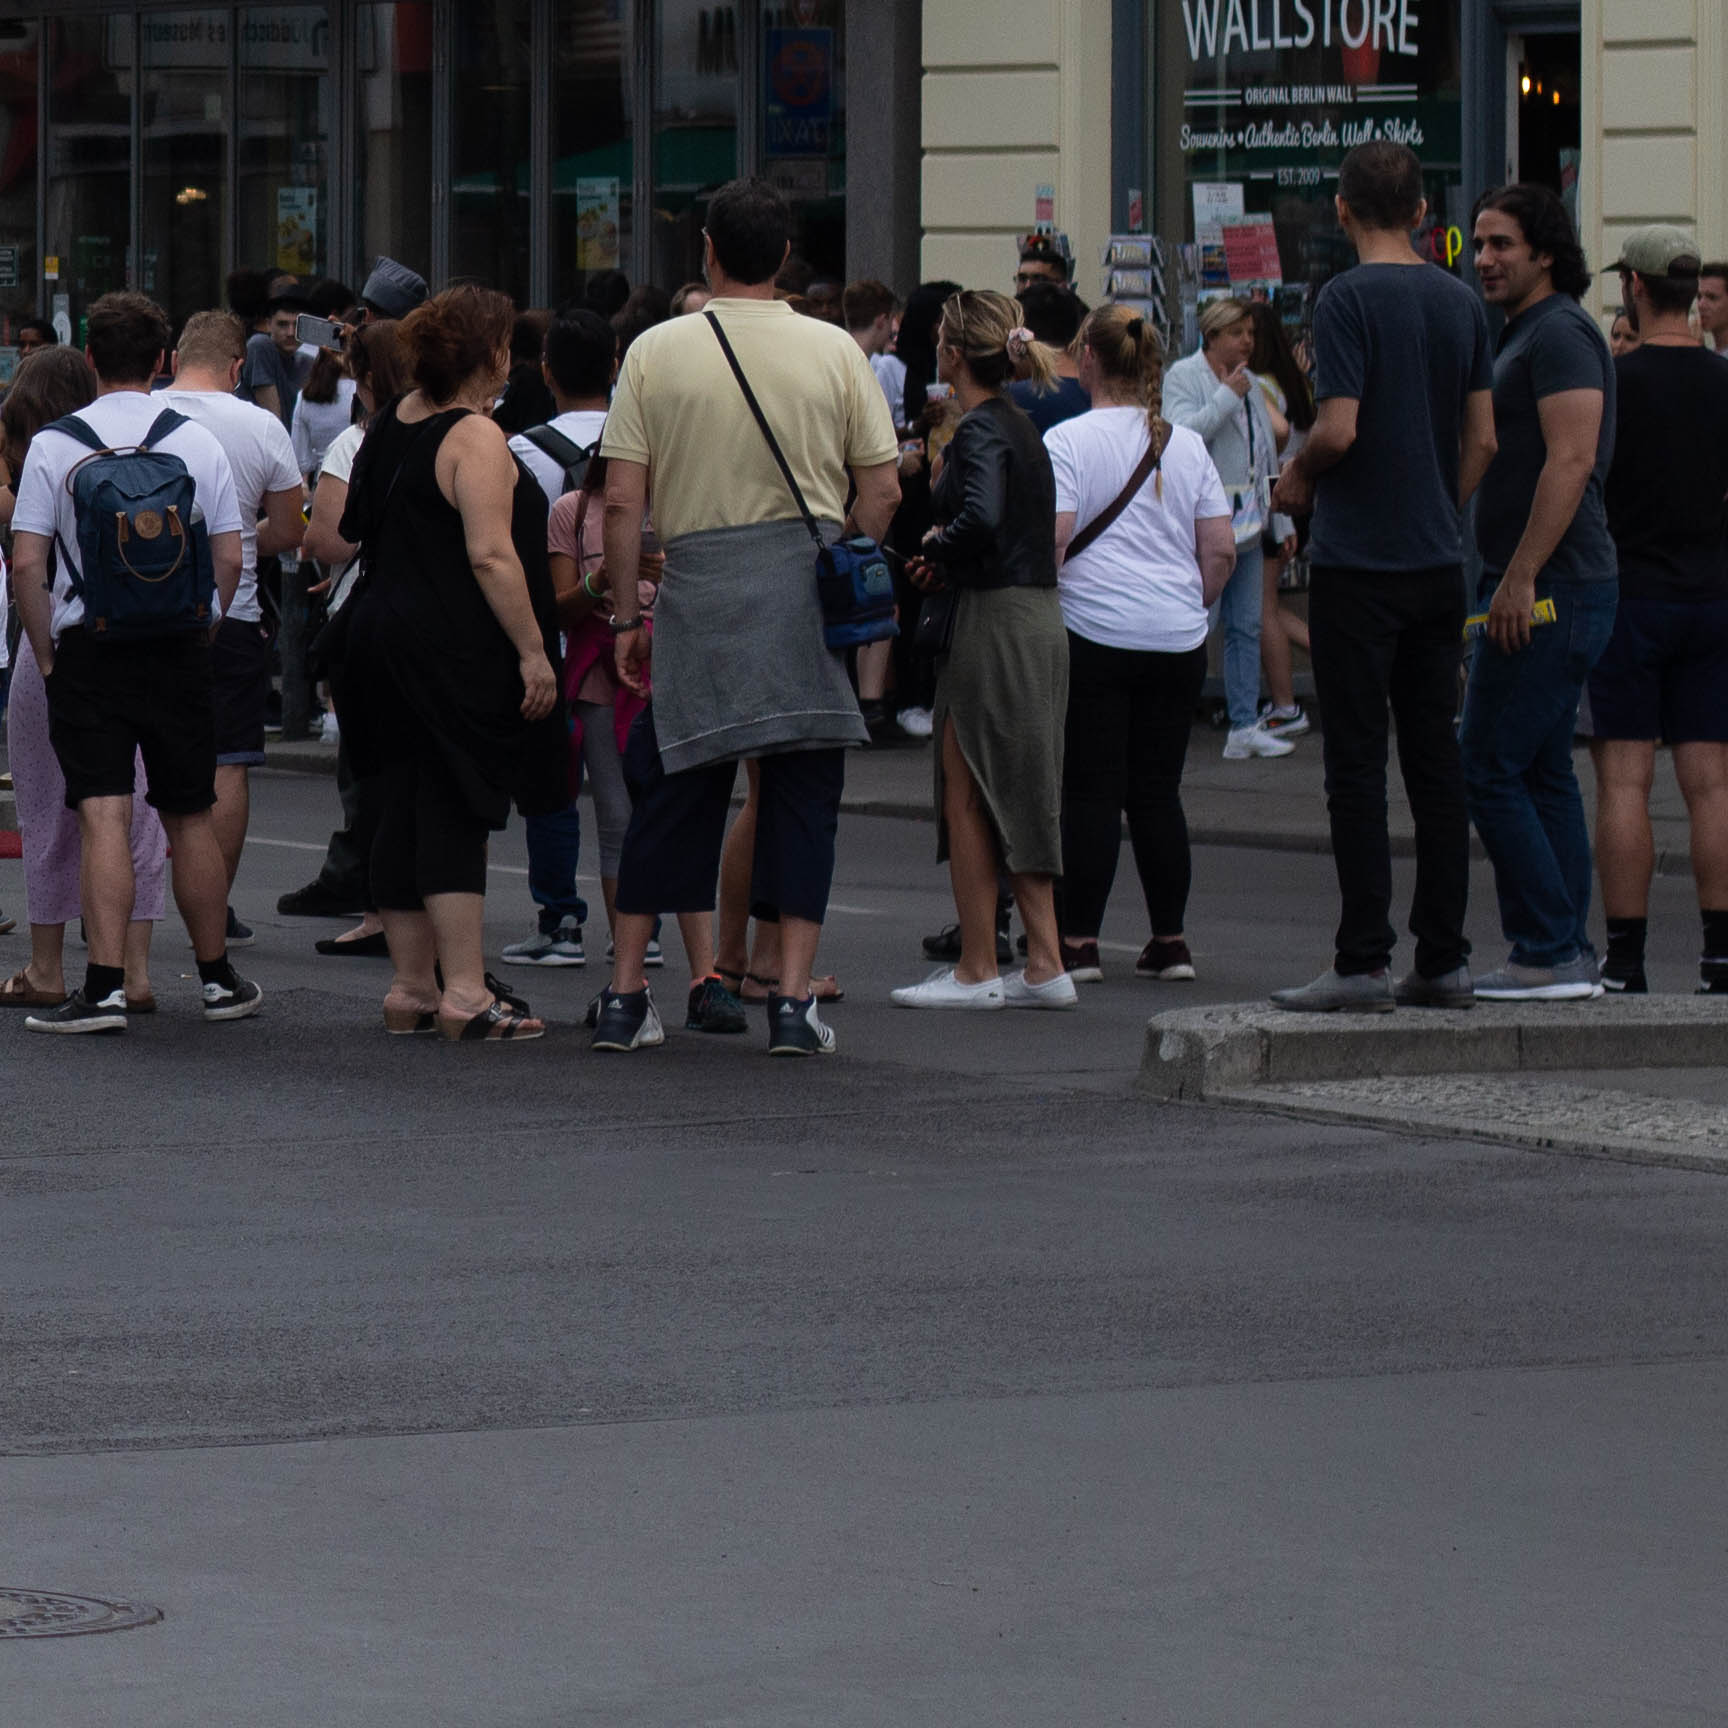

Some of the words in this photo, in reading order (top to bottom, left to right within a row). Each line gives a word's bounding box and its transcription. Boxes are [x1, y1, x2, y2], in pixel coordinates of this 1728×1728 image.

[1245, 85, 1291, 105] ORIGINAL
[1292, 84, 1327, 104] BERLIN
[1327, 84, 1353, 104] WALL
[1179, 123, 1236, 151] Souvenirs
[1244, 120, 1301, 150] Authentic
[1302, 119, 1340, 148] Berlin
[1383, 116, 1424, 145] Shirts
[1296, 166, 1321, 185] 2009
